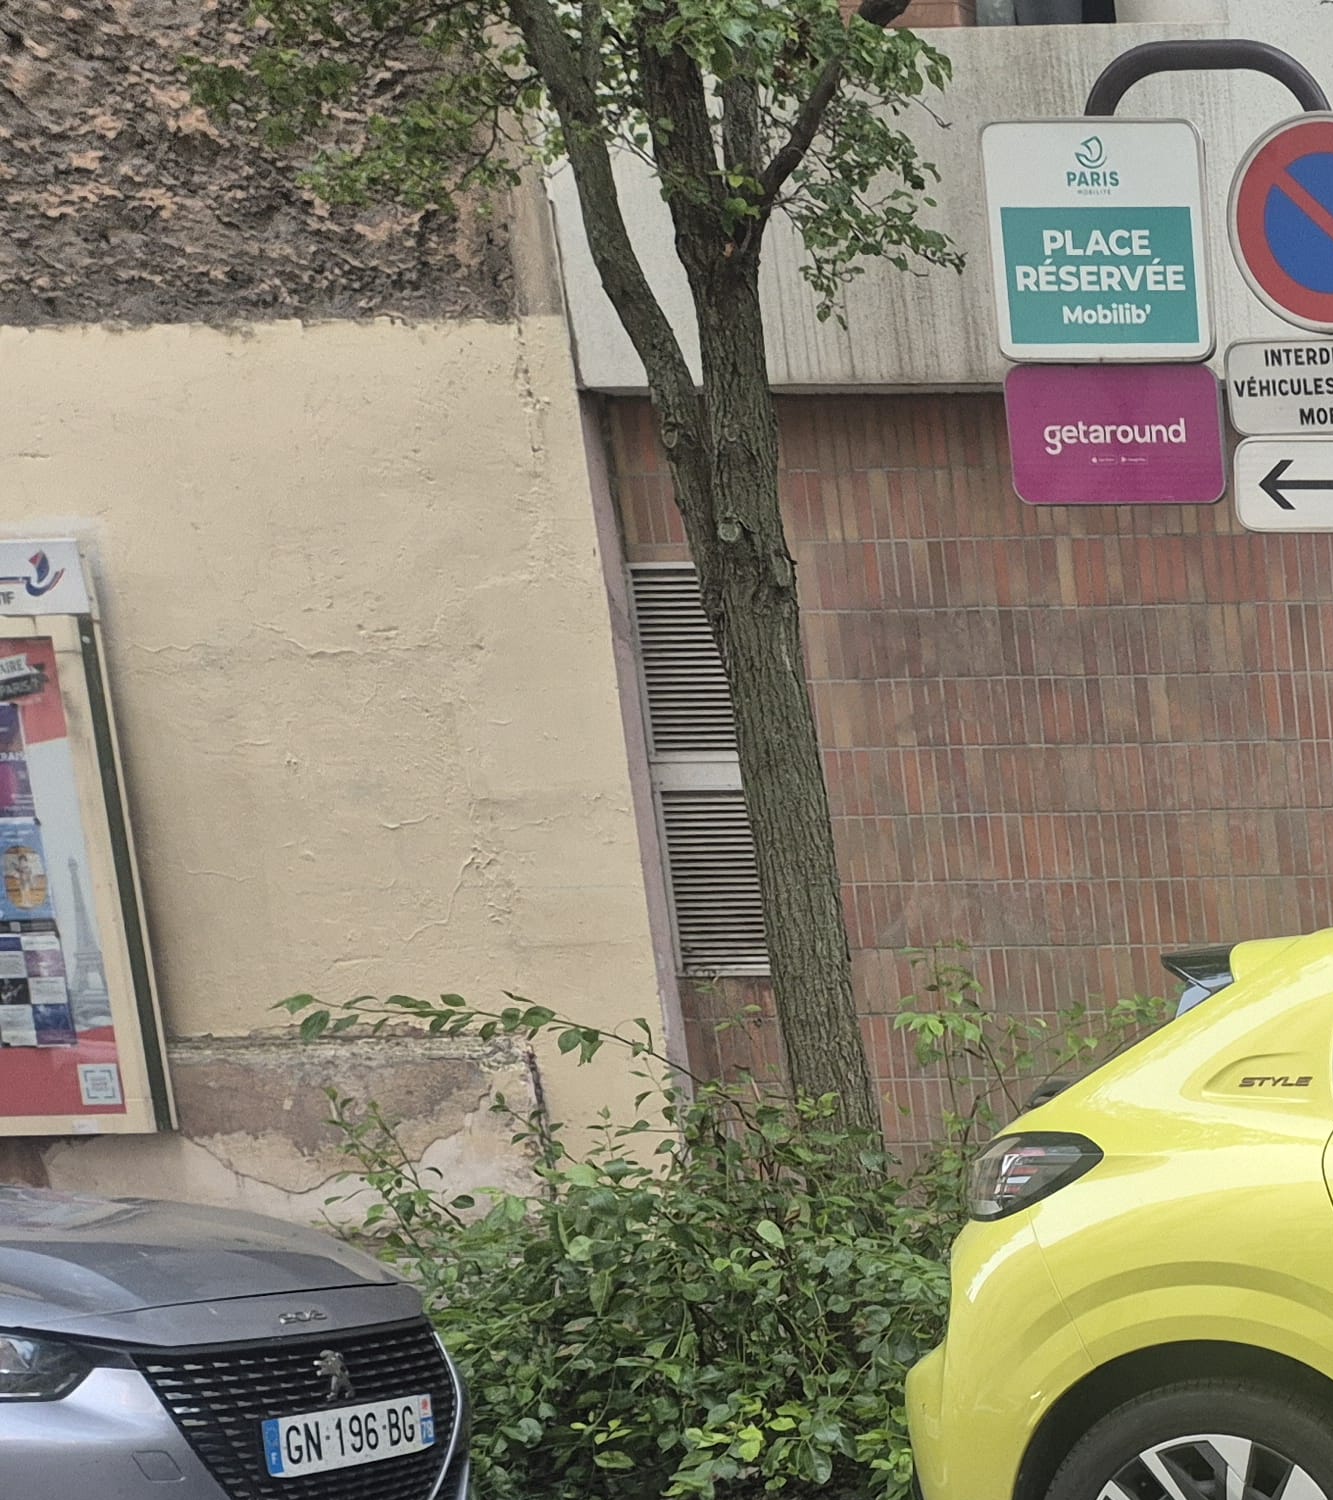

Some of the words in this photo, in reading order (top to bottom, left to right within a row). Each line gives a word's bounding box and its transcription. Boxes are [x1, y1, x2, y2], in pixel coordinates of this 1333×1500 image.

[1066, 171, 1120, 187] PARIS
[1042, 229, 1152, 256] PLACE
[1015, 258, 1186, 292] RÉSERVÉE
[1062, 303, 1152, 325] Mobilib'
[1043, 417, 1187, 455] getaround
[1238, 1076, 1313, 1087] STYLE
